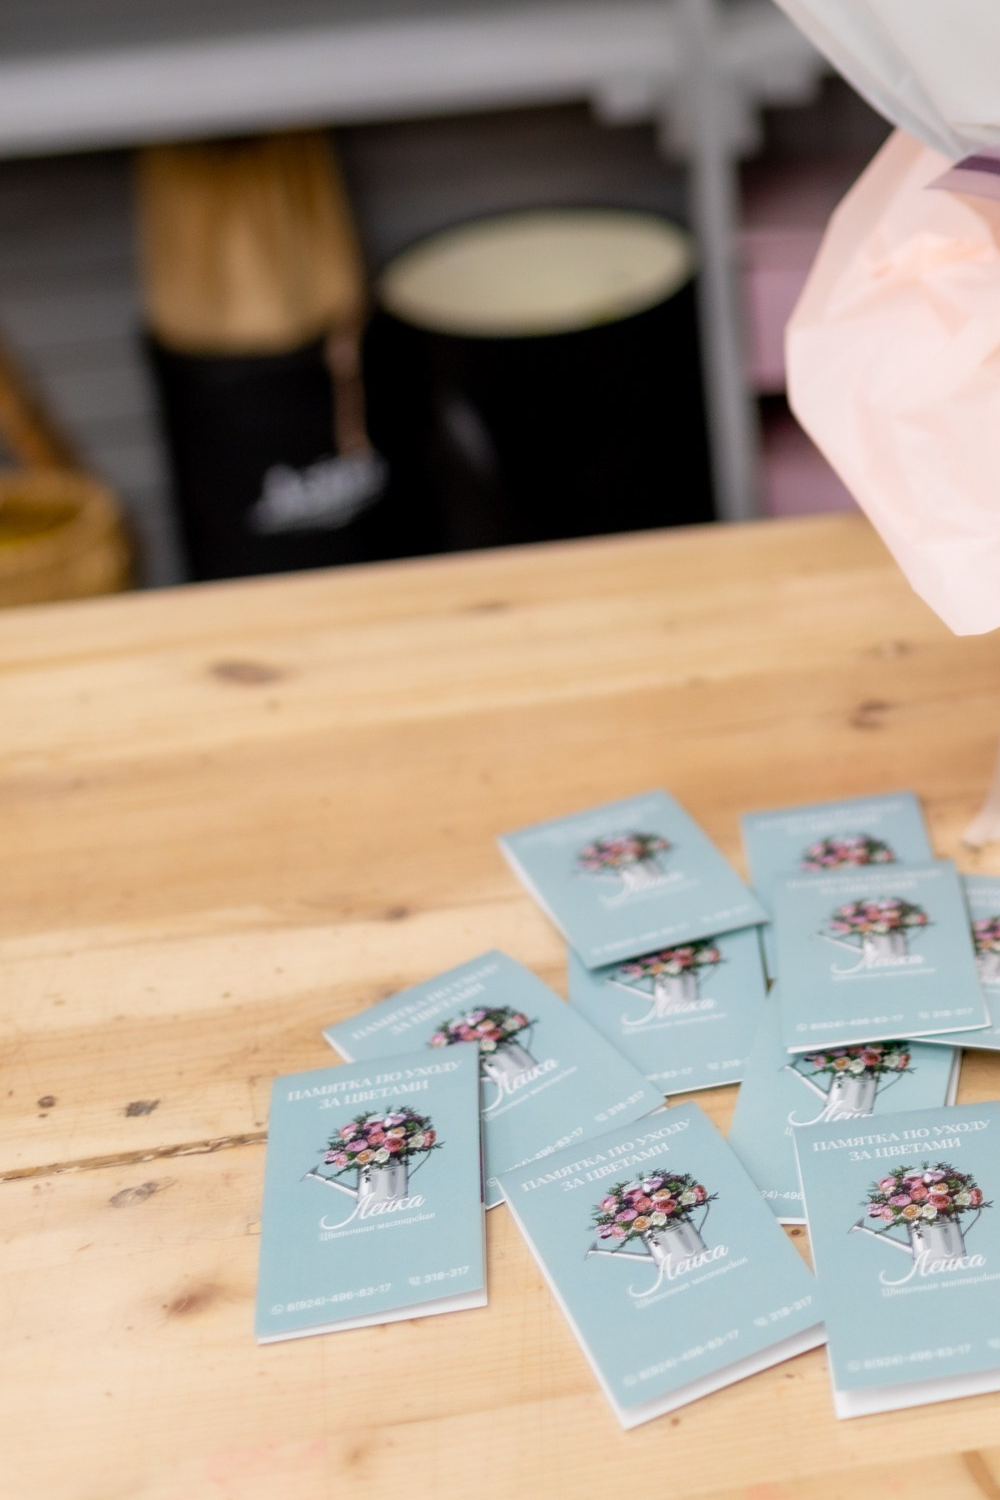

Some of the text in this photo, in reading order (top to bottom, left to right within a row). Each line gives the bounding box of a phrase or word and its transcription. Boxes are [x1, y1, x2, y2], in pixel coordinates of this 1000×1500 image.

[287, 1060, 463, 1102] ПАМЯТКА ПО УХОДУ
[319, 1080, 428, 1110] ЗА ЦВЕТАМИ
[812, 1119, 992, 1152] ПАМЯТКА ПО УХОДУ
[849, 1138, 962, 1162] ЗА ЦВЕТАМИ
[521, 1119, 692, 1193] ПАМЯТКА ПО УХОДУ
[561, 1143, 671, 1192] ЗА ЦВЕТАМИ
[319, 1192, 426, 1230] Лейка
[628, 1245, 729, 1298] Лейка
[879, 1249, 987, 1286] Лейка
[287, 1267, 470, 1312] 8(924)-496-83-17 318-317
